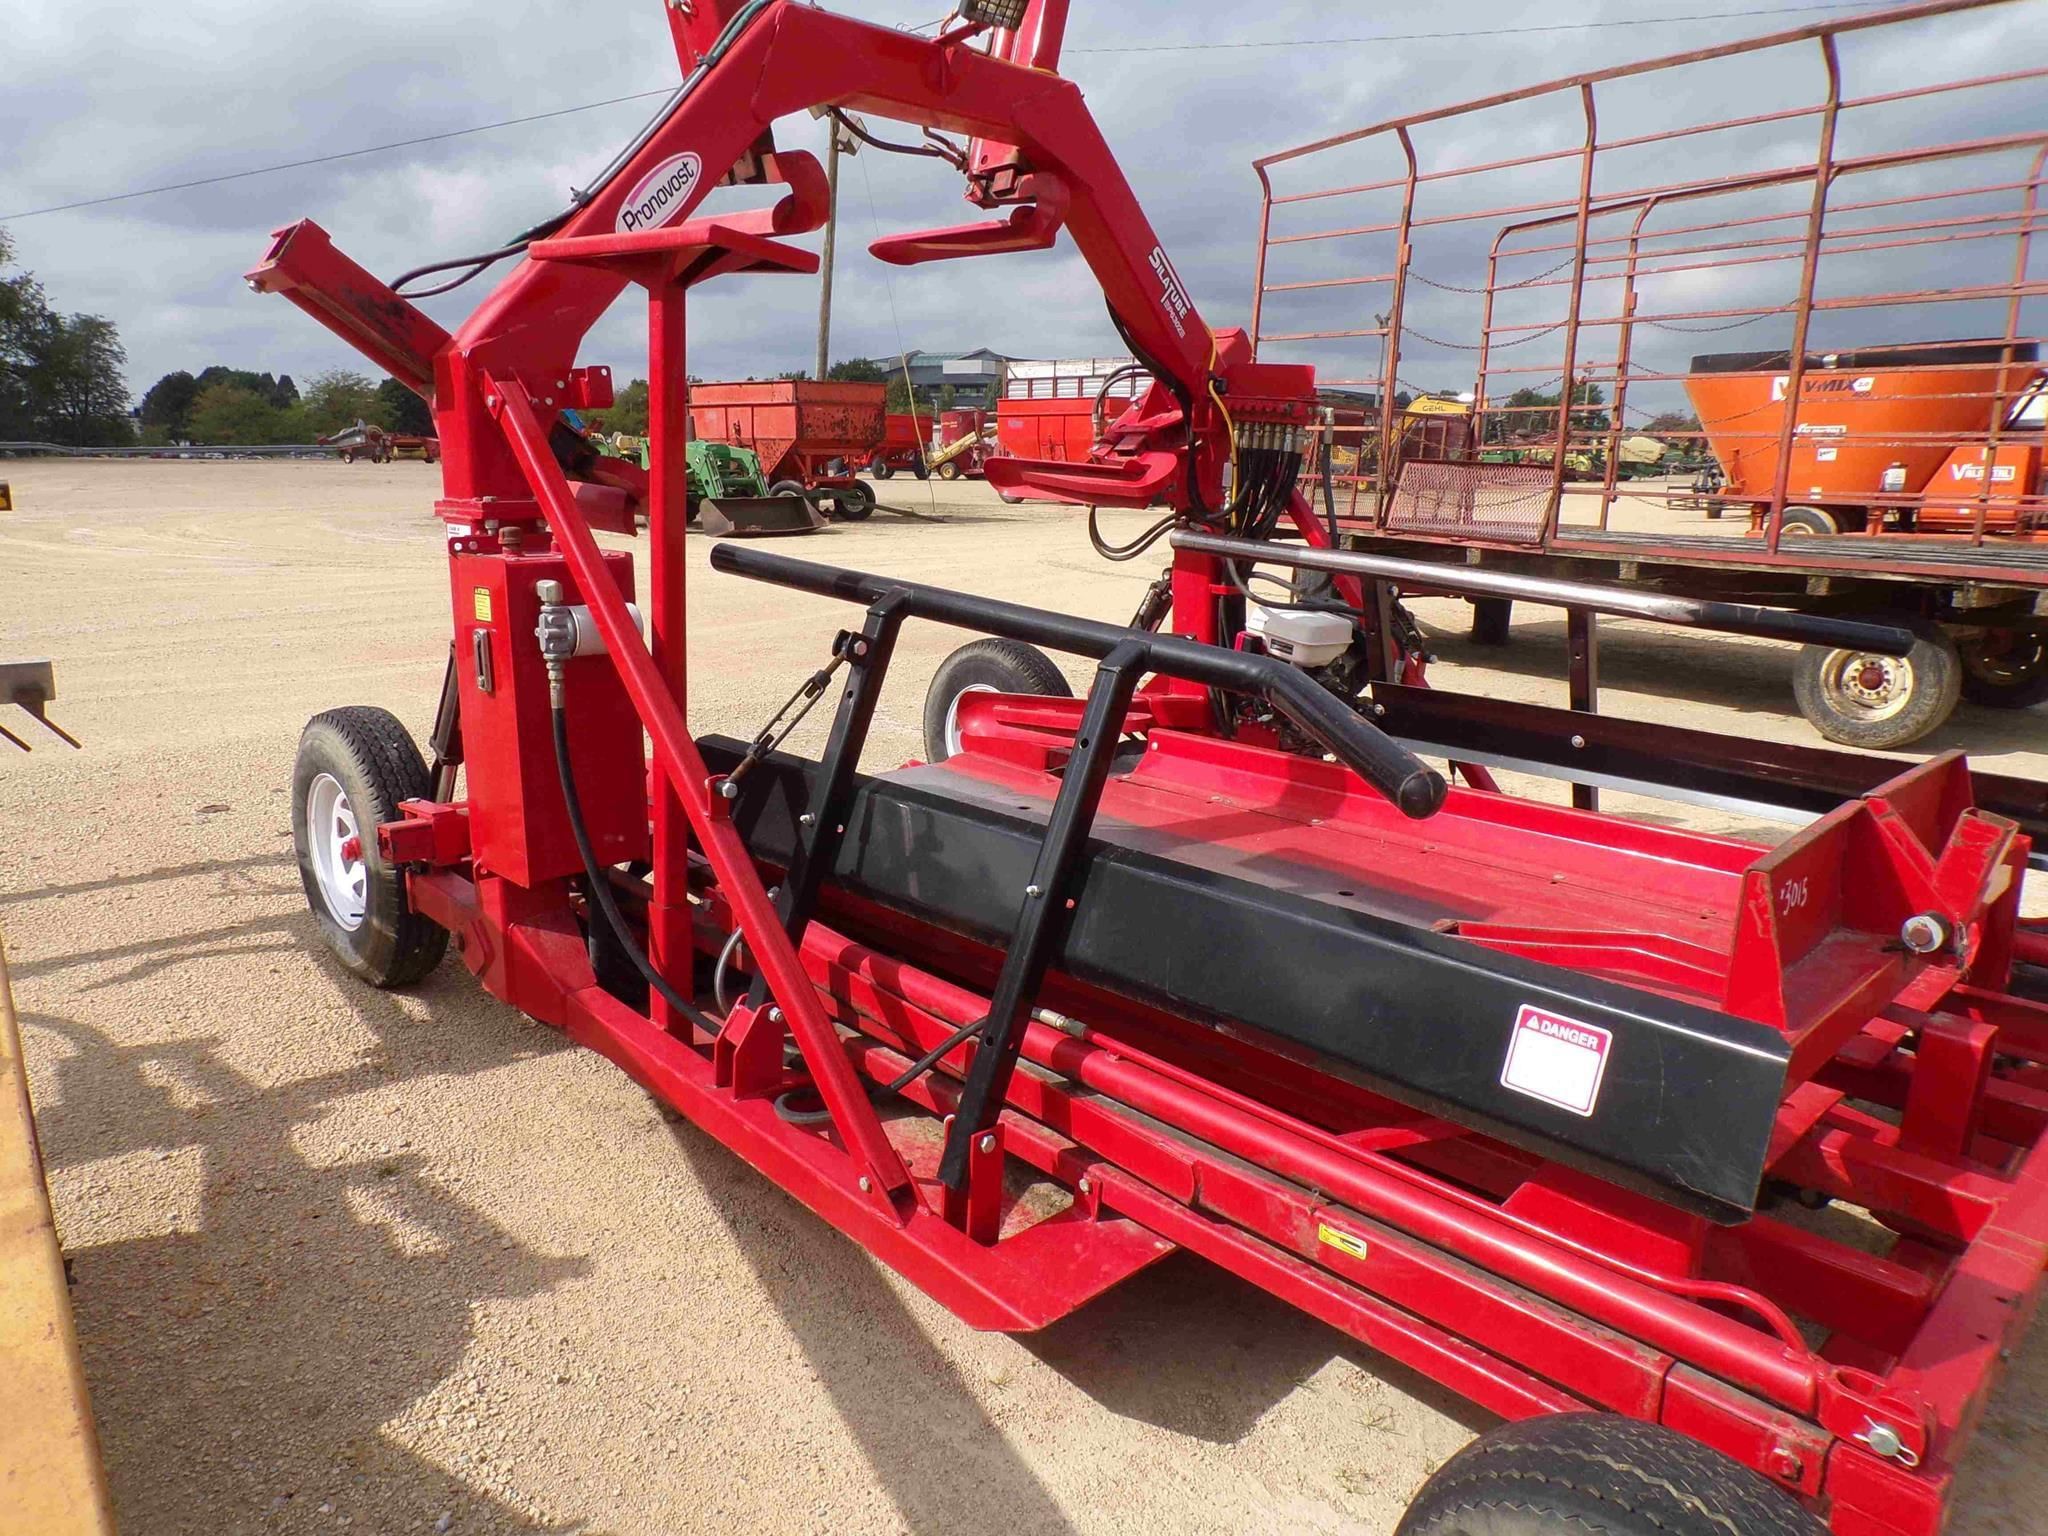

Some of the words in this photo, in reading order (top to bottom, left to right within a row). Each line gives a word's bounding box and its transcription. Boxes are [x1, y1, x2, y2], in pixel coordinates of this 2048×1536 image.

[622, 161, 695, 232] Pronovost
[1148, 246, 1191, 319] SILATUBE
[1540, 1020, 1599, 1050] DANGER
